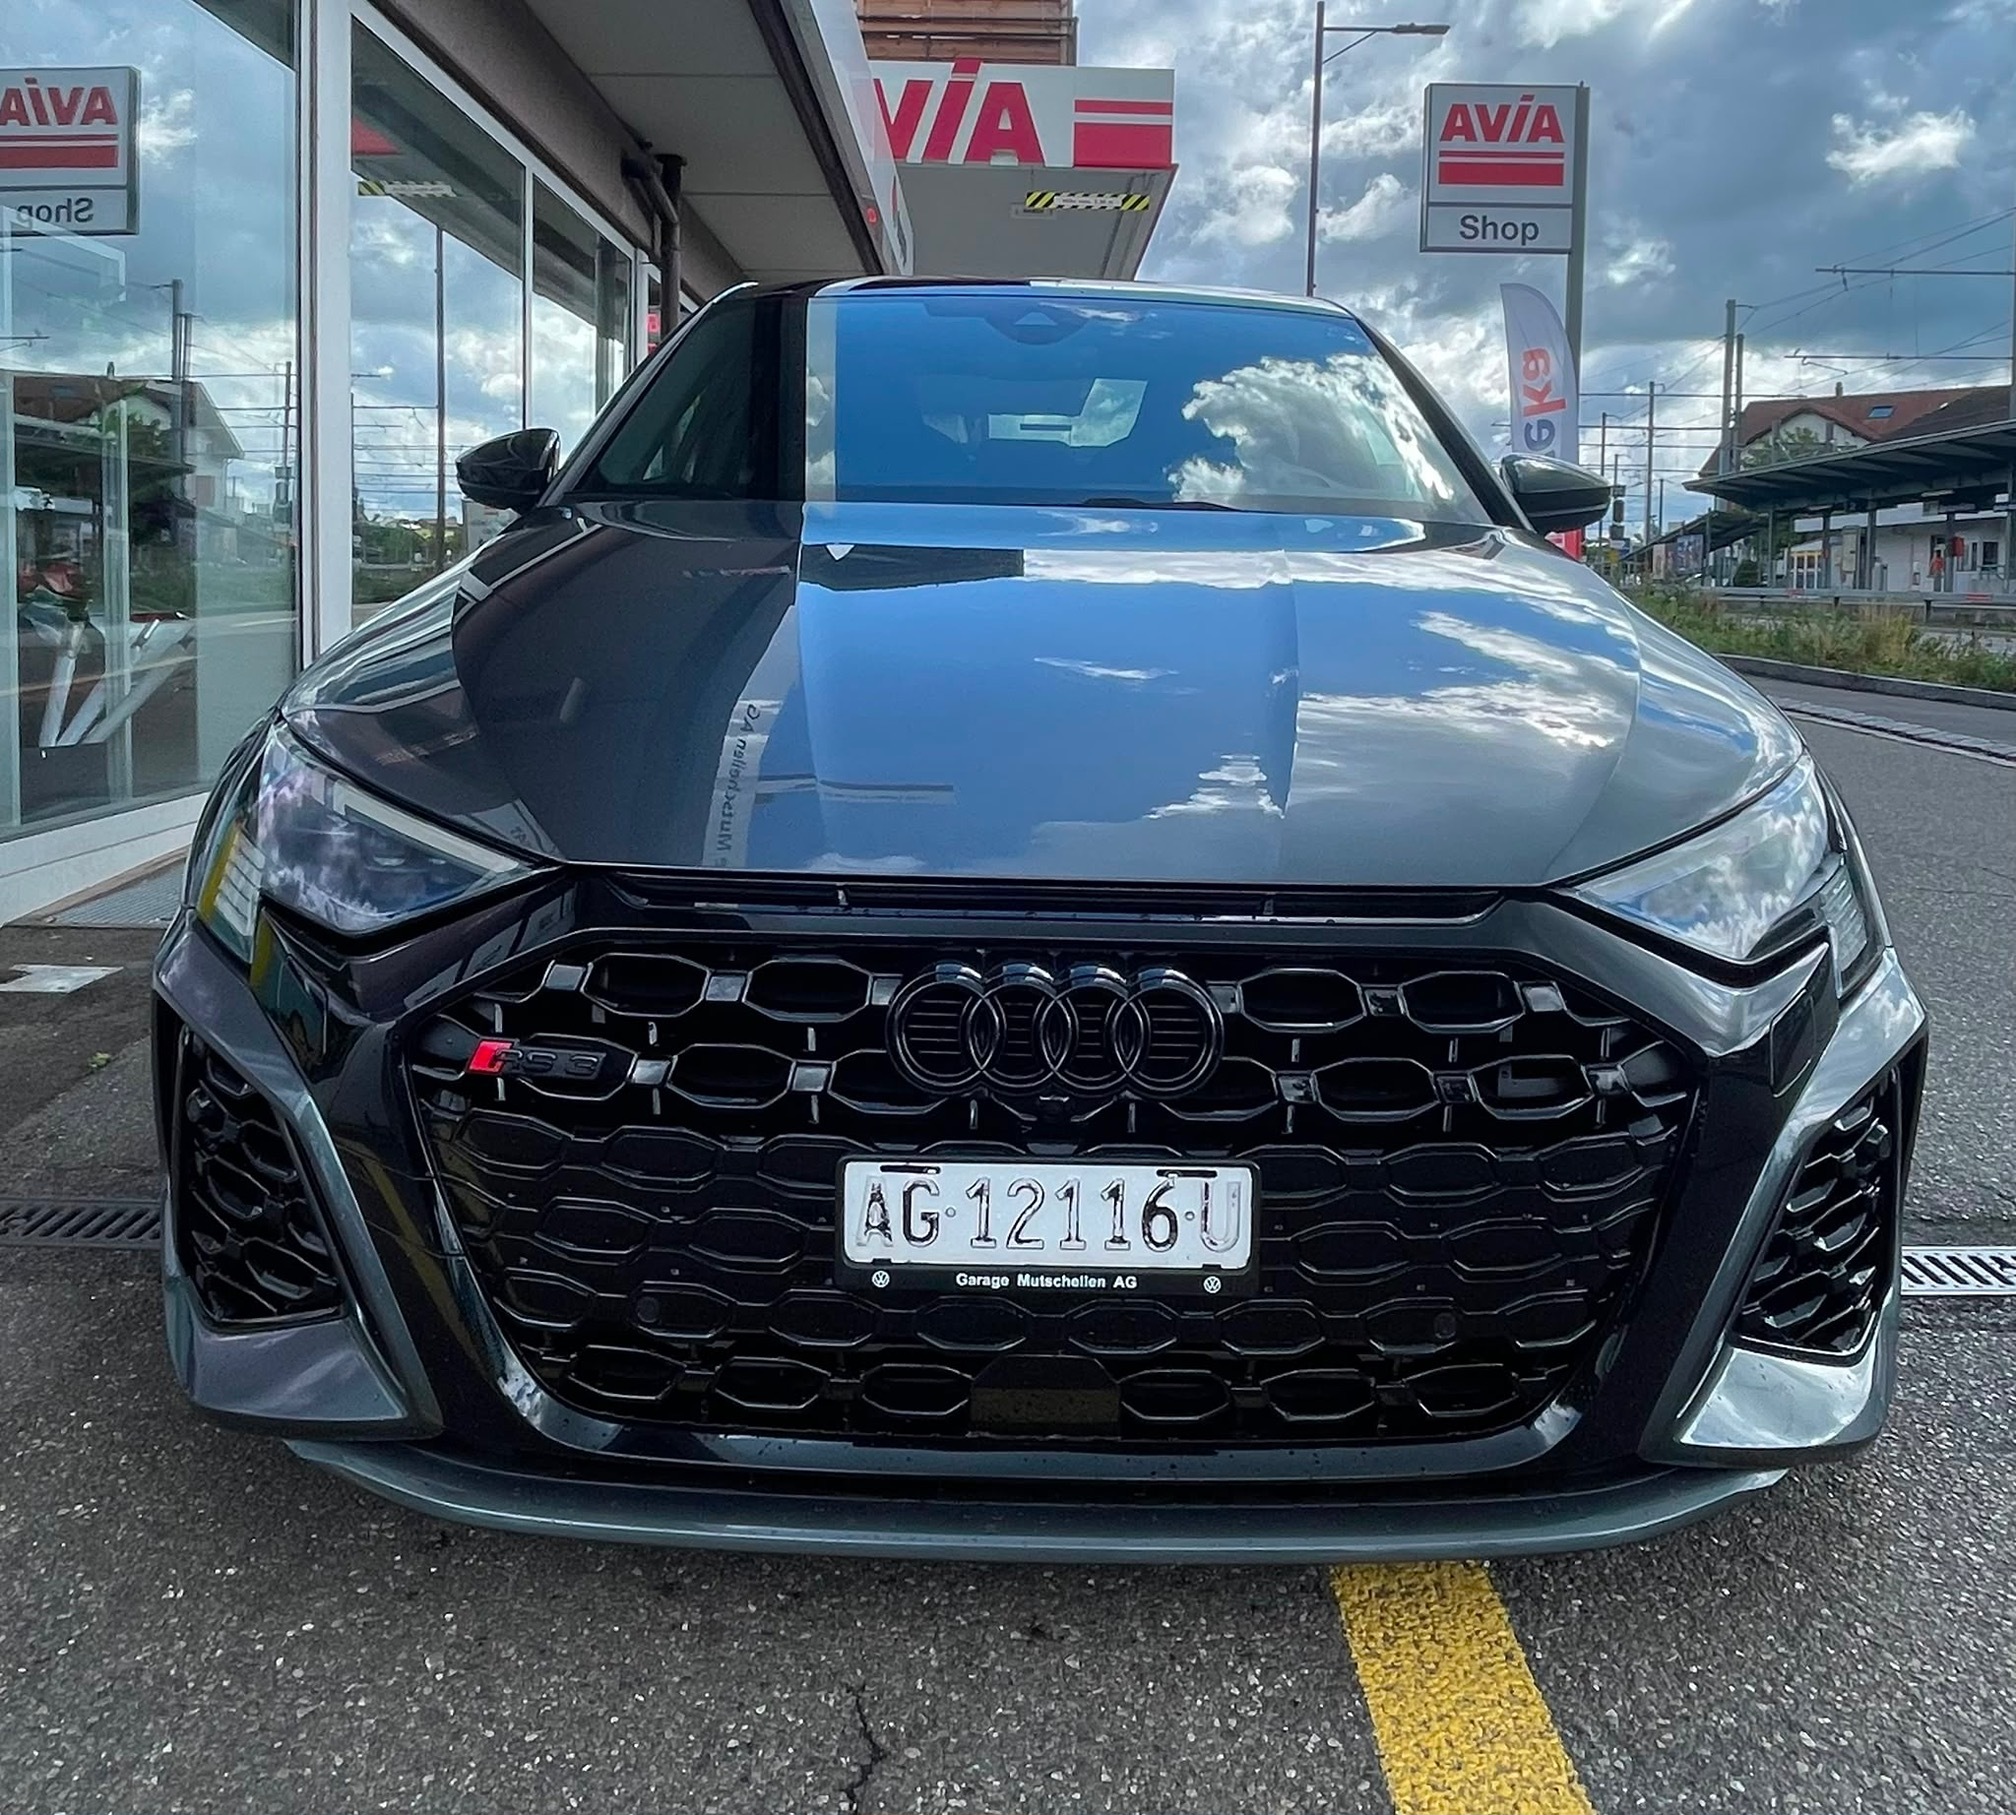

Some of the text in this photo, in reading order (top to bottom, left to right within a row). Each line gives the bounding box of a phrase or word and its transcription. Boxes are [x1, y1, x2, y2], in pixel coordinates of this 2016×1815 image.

[1459, 214, 1539, 246] Shop
[955, 1273, 1138, 1290] Garage Mutschellen AG
